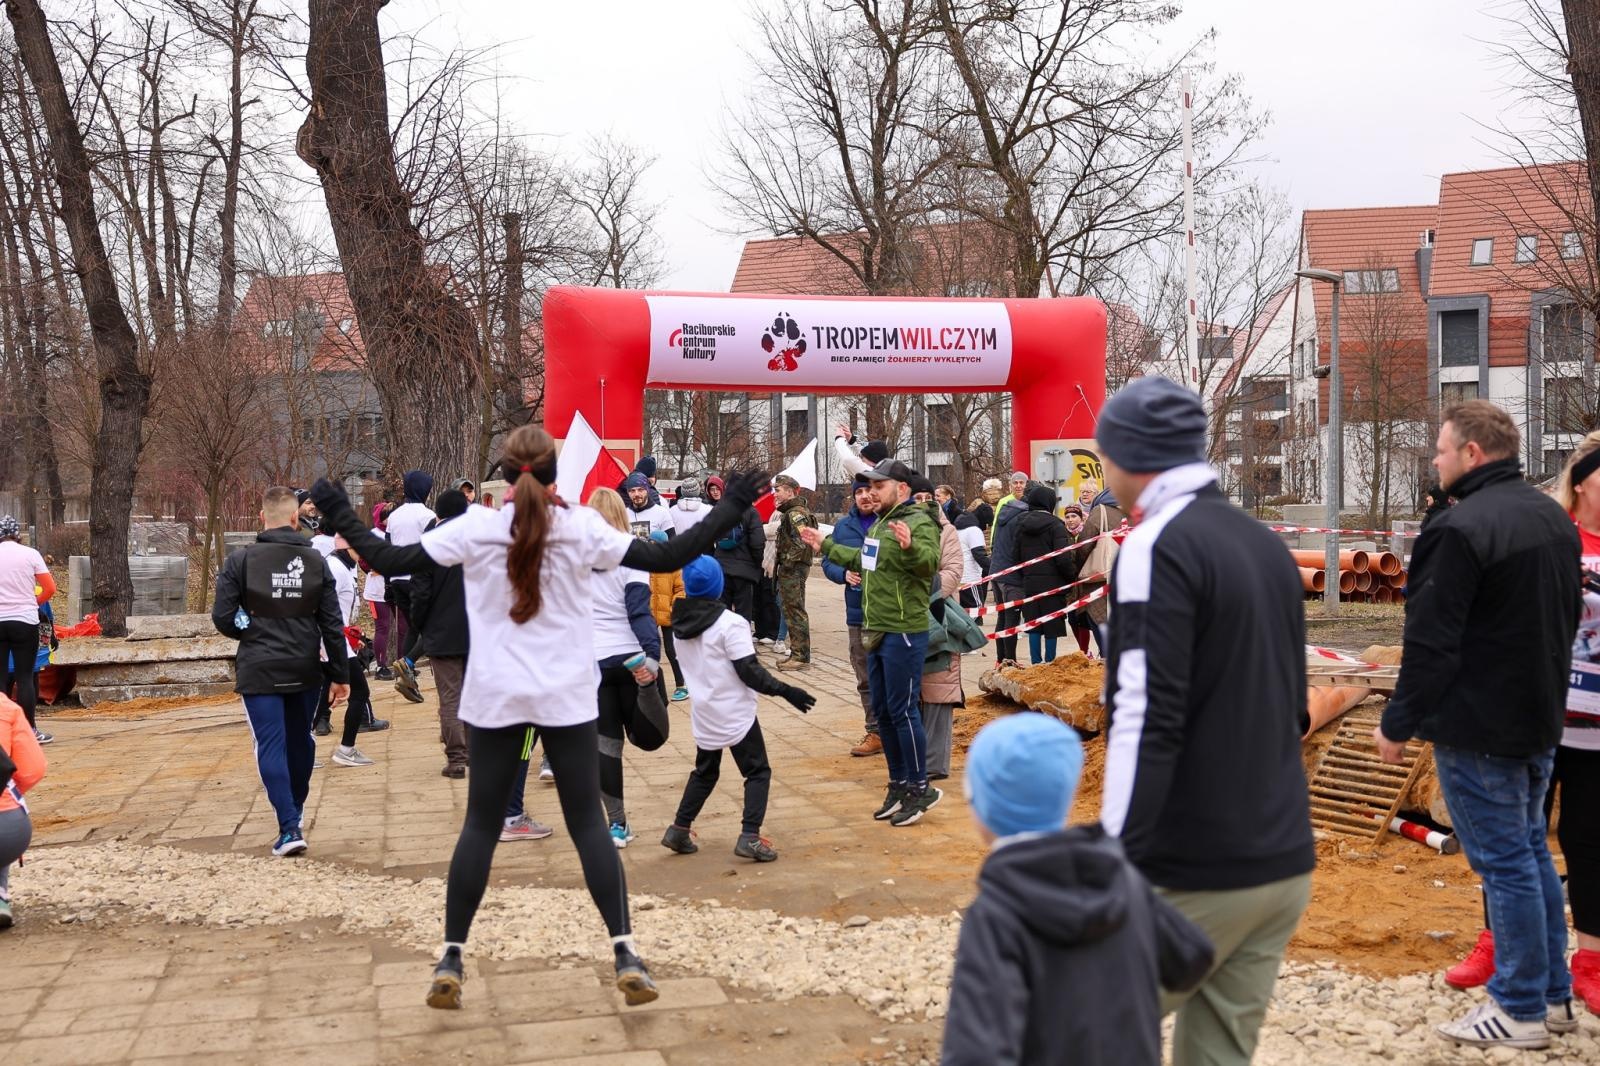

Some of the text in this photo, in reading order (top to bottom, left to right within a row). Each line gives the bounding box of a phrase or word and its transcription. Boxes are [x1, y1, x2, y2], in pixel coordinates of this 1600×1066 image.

[682, 323, 736, 336] Raciborskie
[683, 347, 716, 361] Kultury
[887, 355, 931, 363] ŻOŁNIERZY
